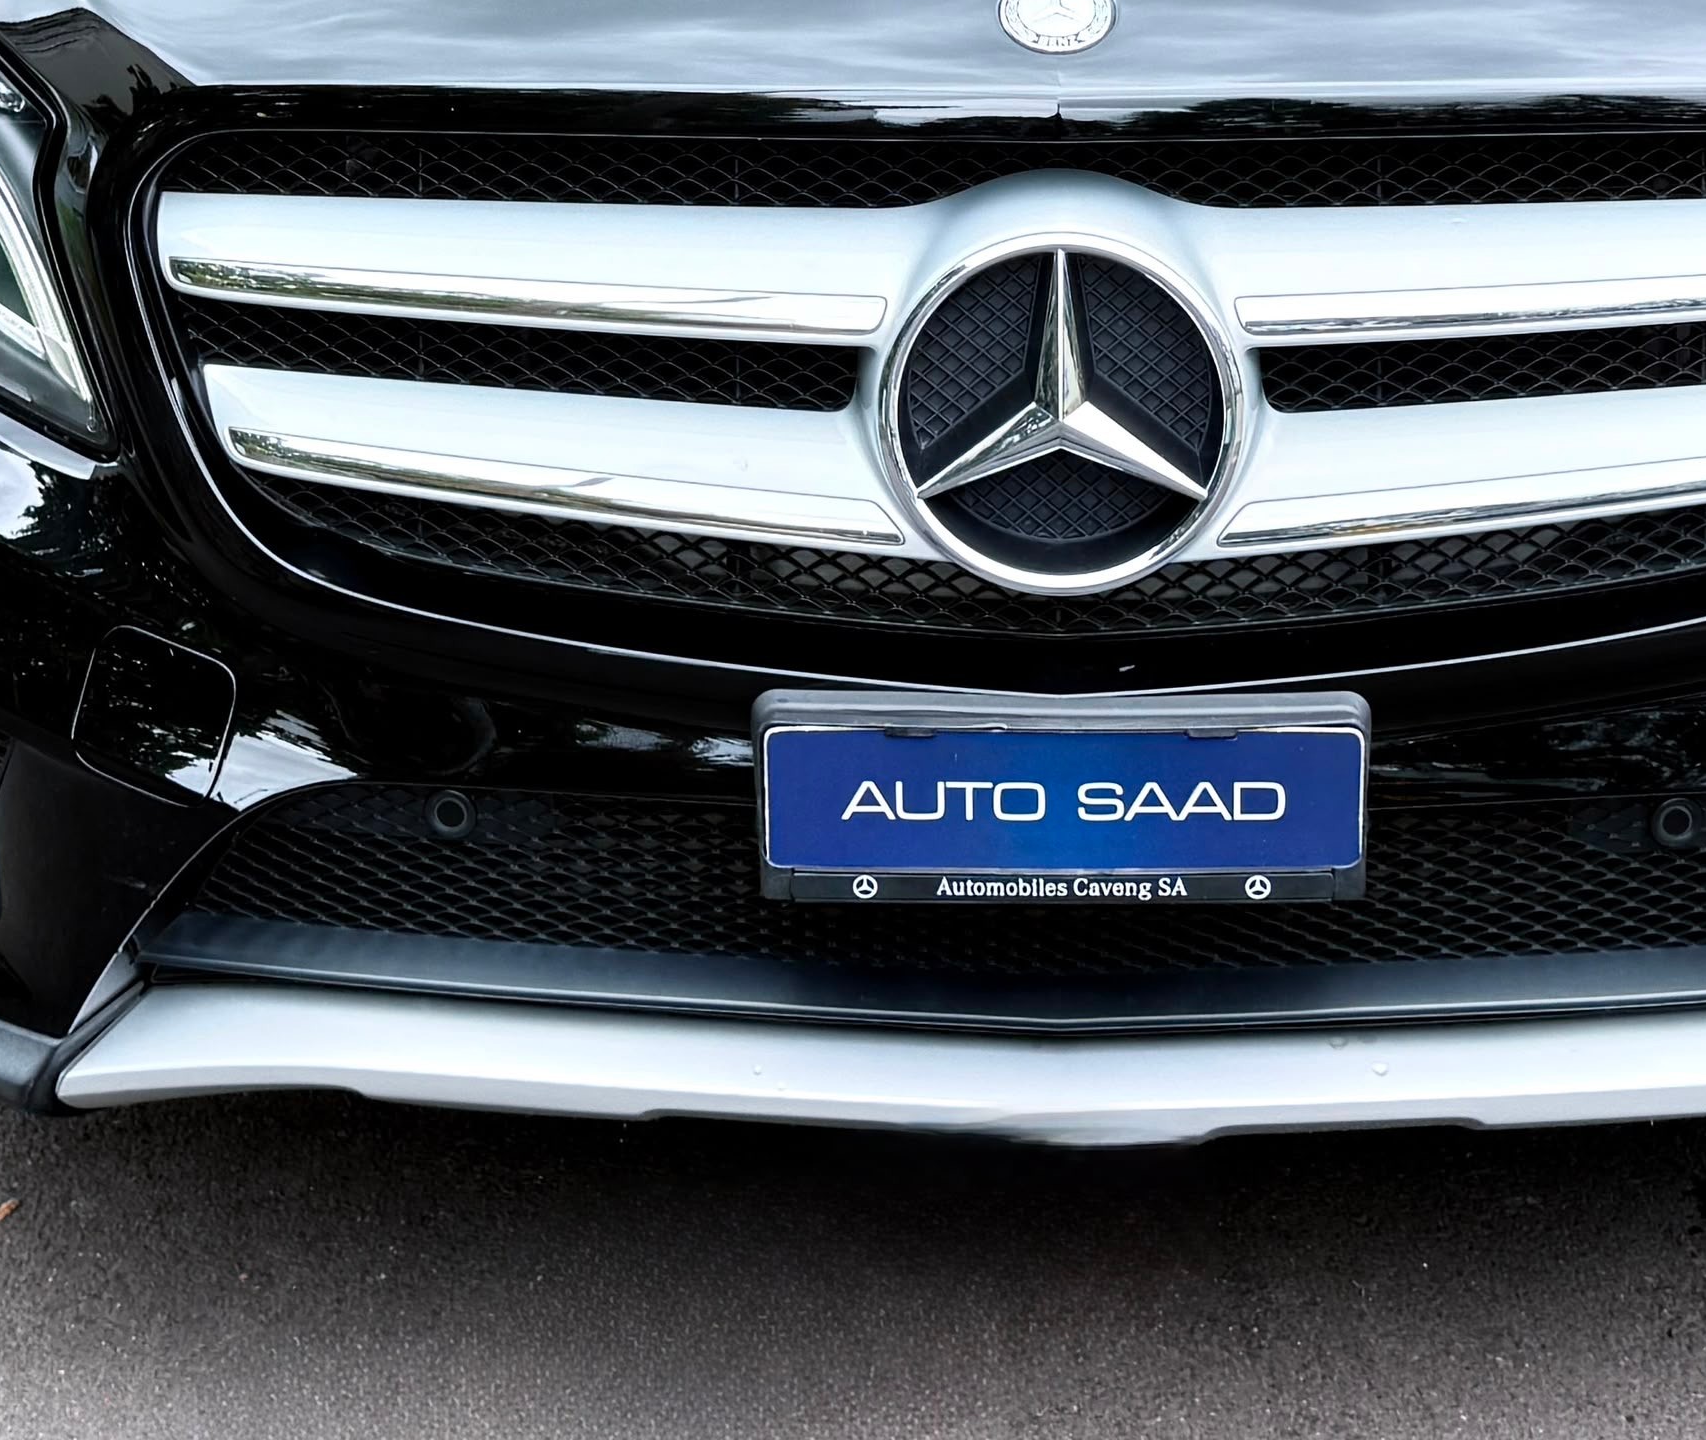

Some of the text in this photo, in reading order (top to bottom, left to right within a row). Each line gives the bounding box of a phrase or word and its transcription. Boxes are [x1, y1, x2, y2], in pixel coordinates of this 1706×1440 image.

[841, 780, 1286, 821] AUTO SAAD
[936, 876, 1188, 901] Automobiles Caveng SA
